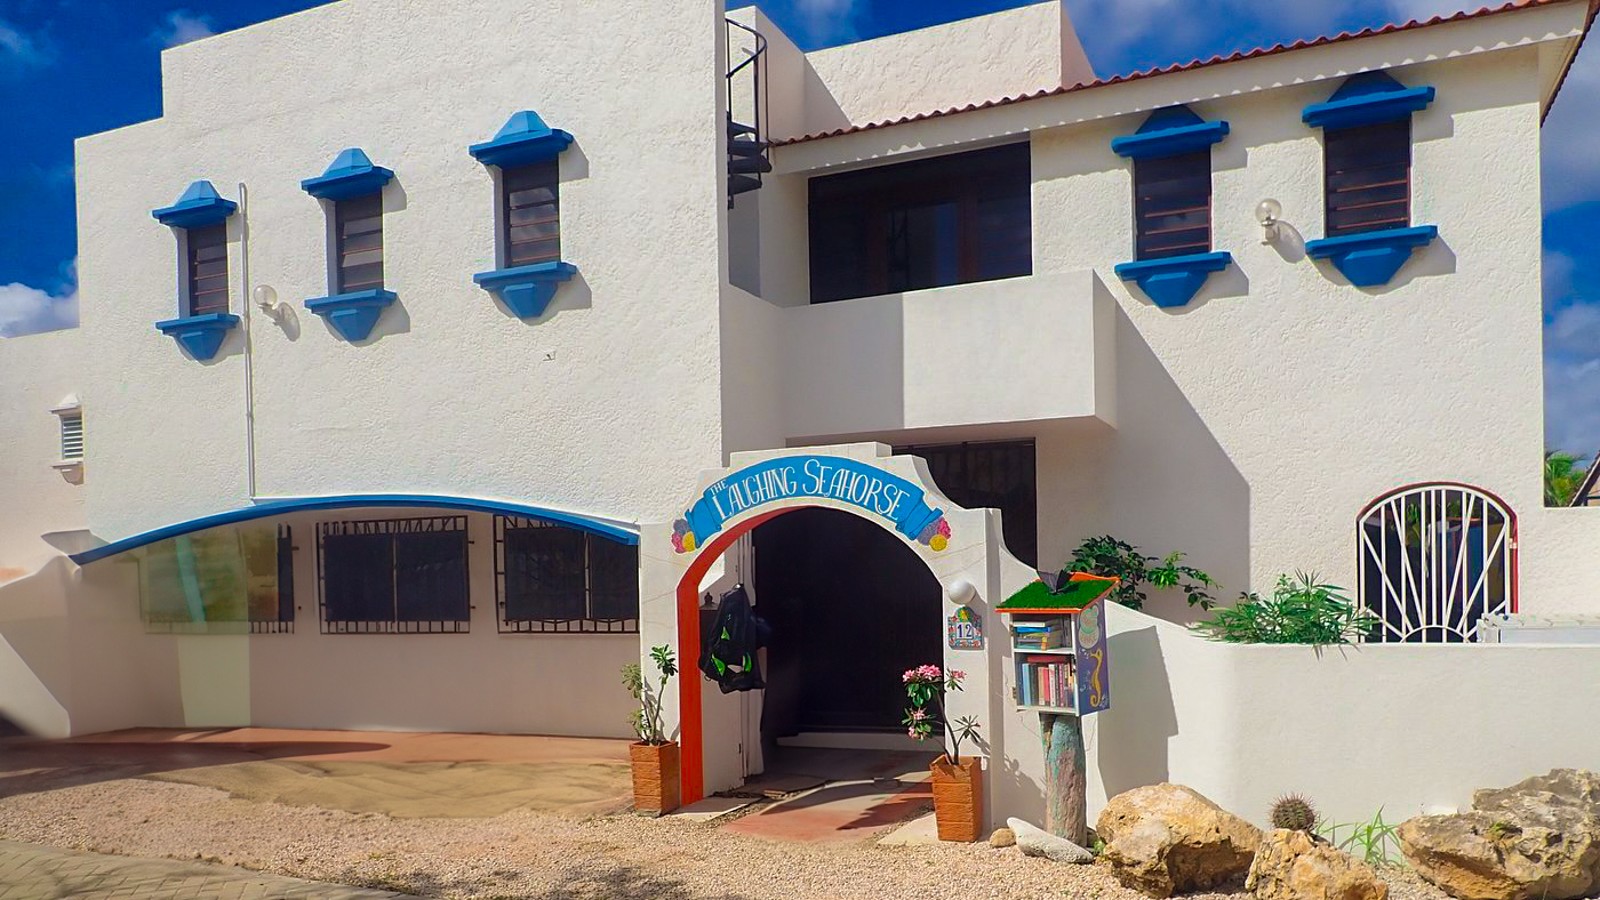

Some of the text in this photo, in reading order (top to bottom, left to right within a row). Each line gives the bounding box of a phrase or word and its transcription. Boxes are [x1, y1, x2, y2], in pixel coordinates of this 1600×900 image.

[710, 480, 729, 496] THE
[712, 458, 911, 521] LAUGHING SEAHORSE
[957, 624, 972, 638] 12
